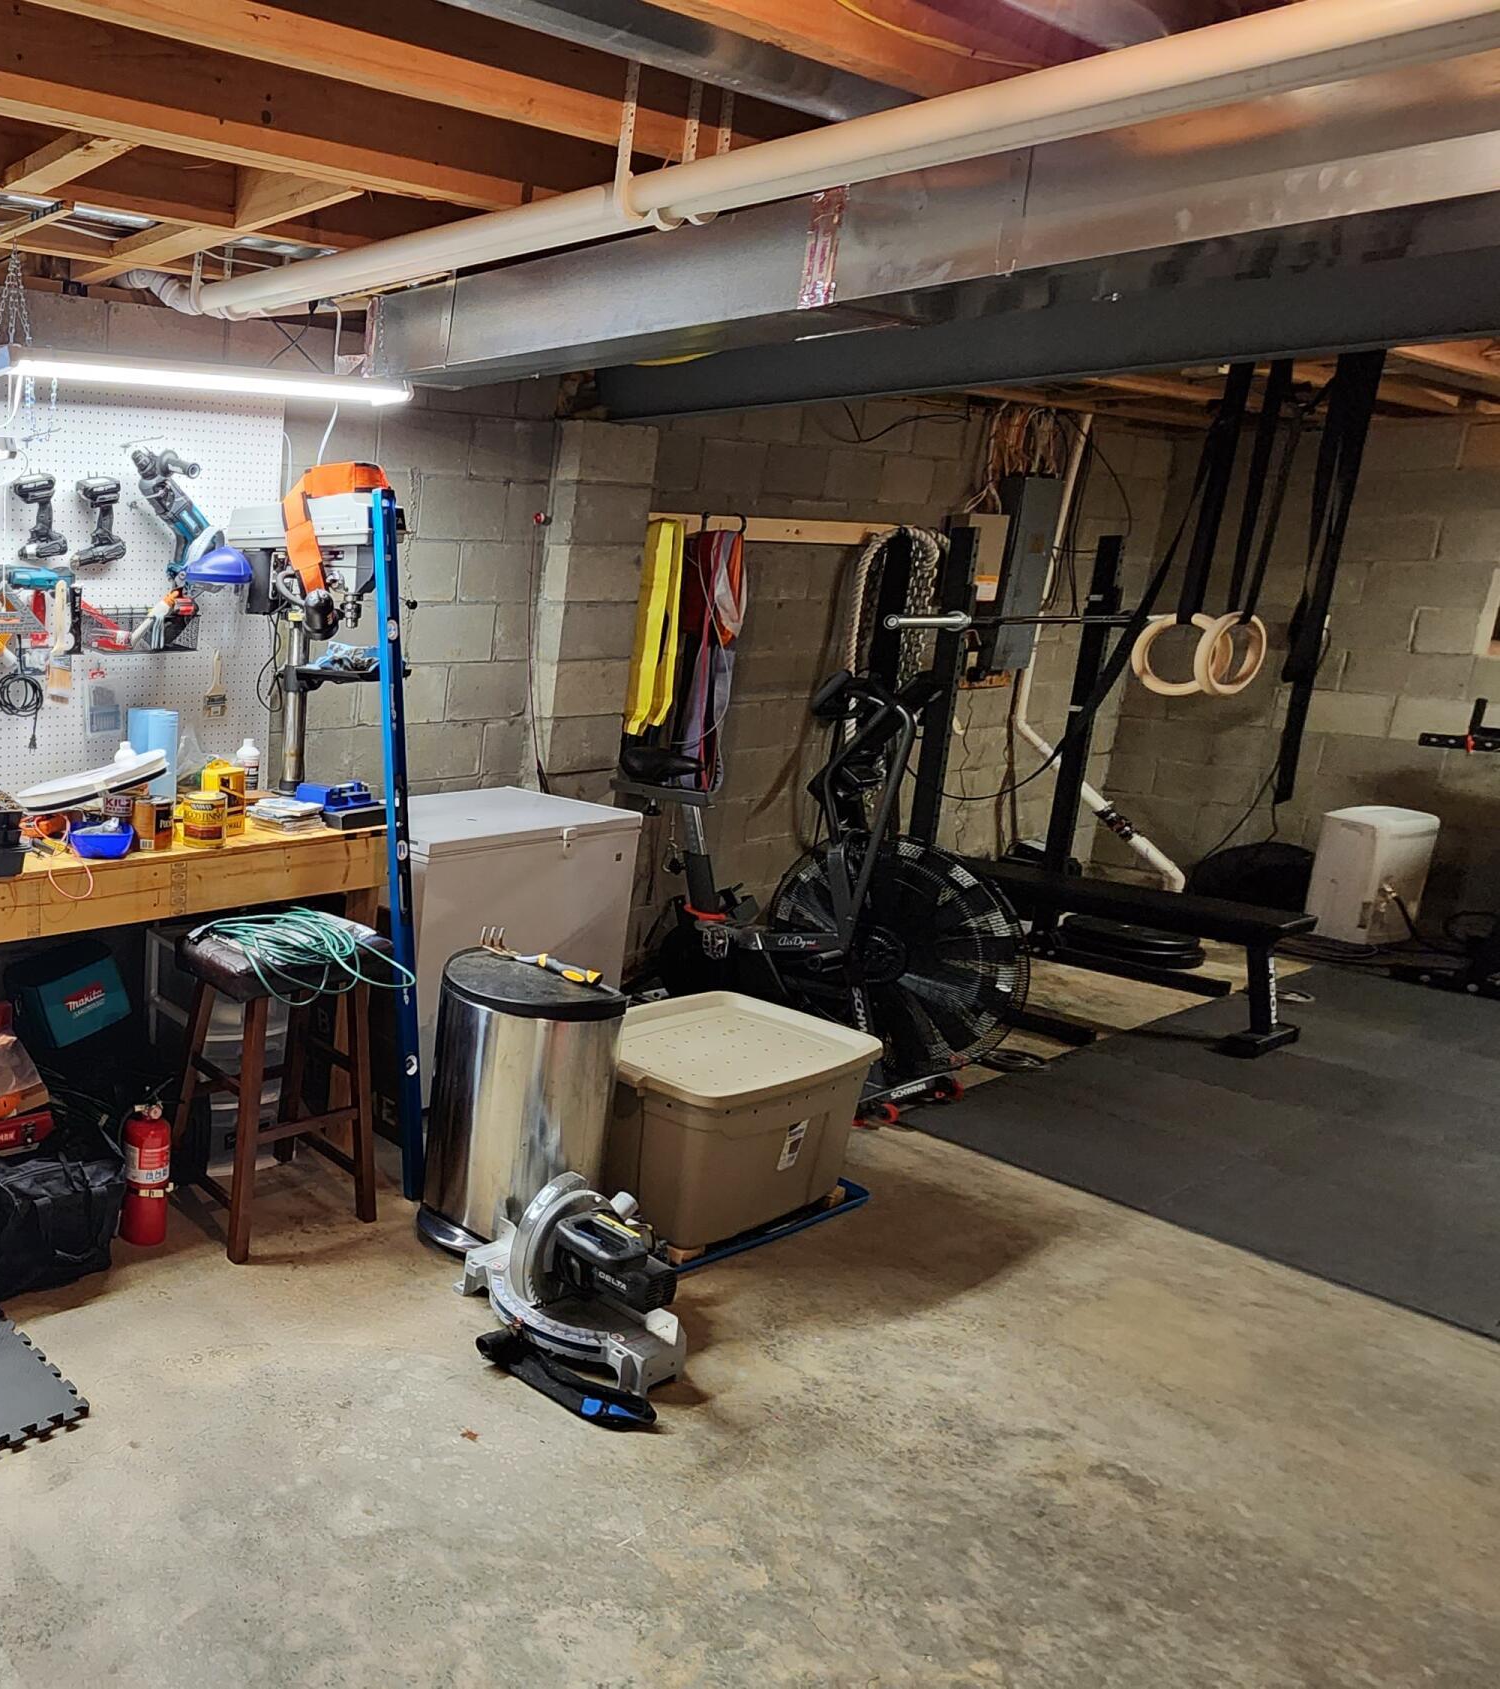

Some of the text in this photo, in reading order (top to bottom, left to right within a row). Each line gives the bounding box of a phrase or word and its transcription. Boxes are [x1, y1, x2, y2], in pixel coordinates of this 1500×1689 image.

[777, 935, 817, 948] AirDyne
[64, 989, 106, 1012] makita
[852, 986, 868, 1033] SCHW
[890, 1083, 927, 1100] SCHWINN
[598, 1270, 628, 1291] DELTA
